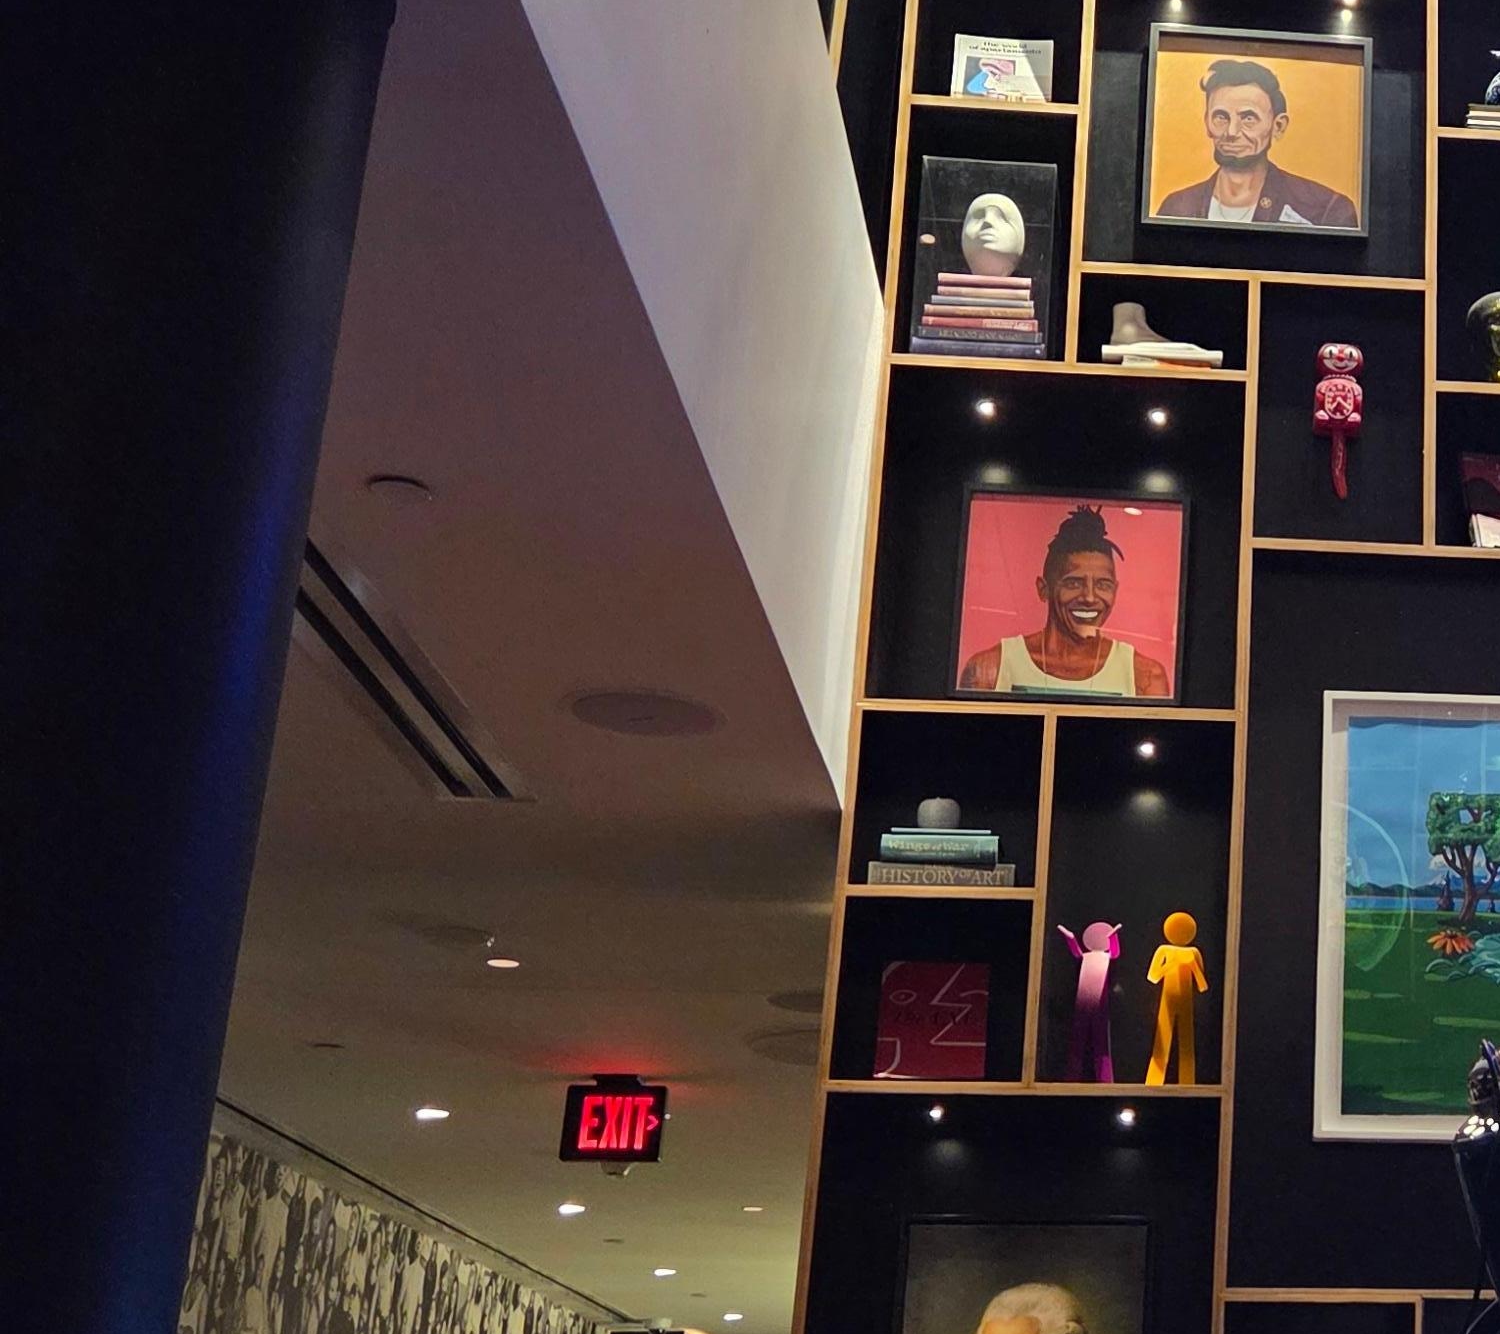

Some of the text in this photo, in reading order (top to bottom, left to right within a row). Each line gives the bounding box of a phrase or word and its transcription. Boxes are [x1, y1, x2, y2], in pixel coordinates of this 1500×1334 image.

[881, 868, 1005, 886] HISTORY OF ART
[578, 1096, 654, 1150] EXIT
